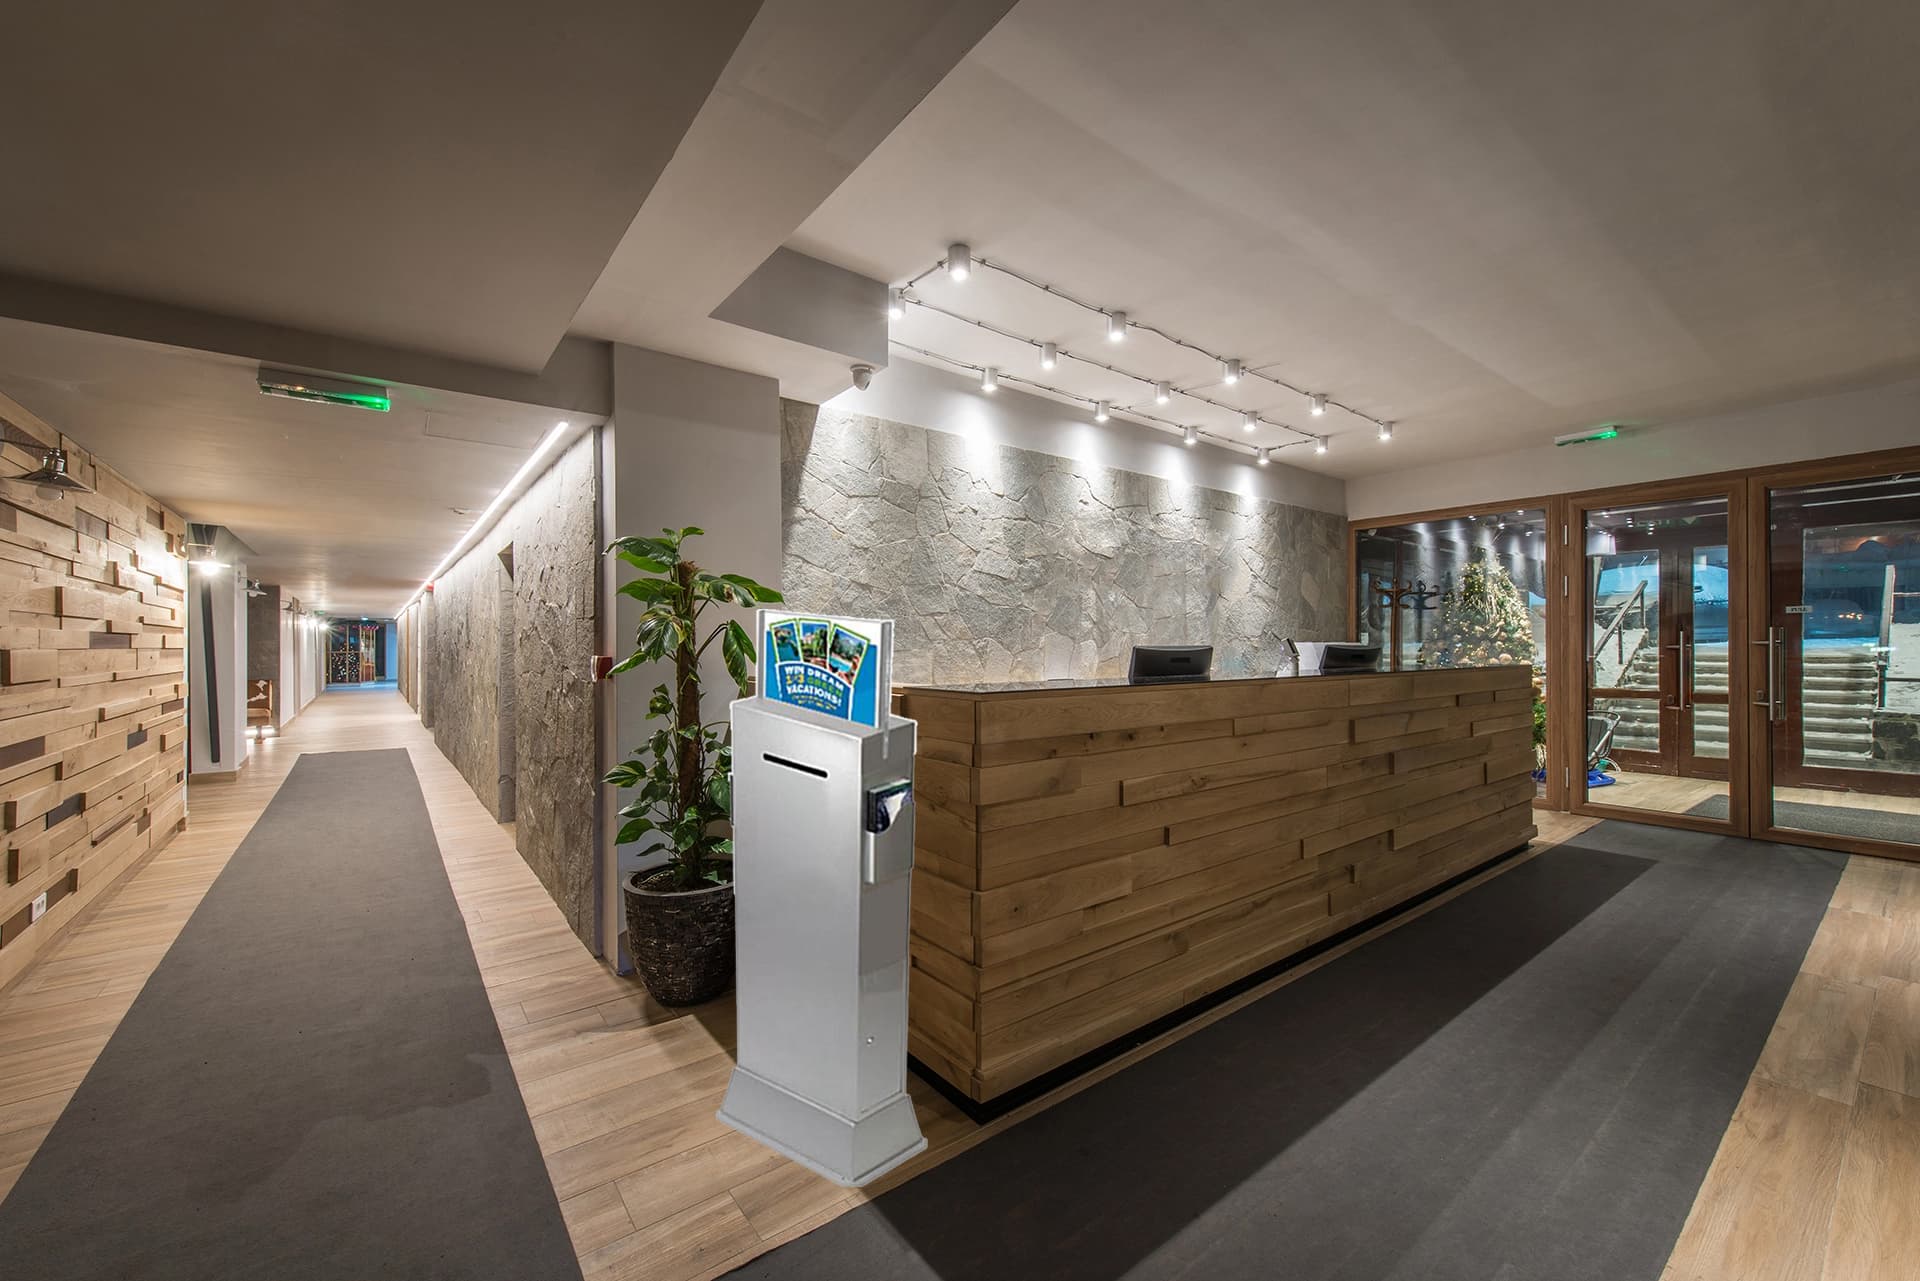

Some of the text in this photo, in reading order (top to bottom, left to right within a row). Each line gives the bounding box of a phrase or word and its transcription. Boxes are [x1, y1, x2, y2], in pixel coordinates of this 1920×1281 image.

[785, 666, 805, 675] WIN
[807, 667, 844, 691] DREAM
[786, 684, 842, 707] VACATIONS!
